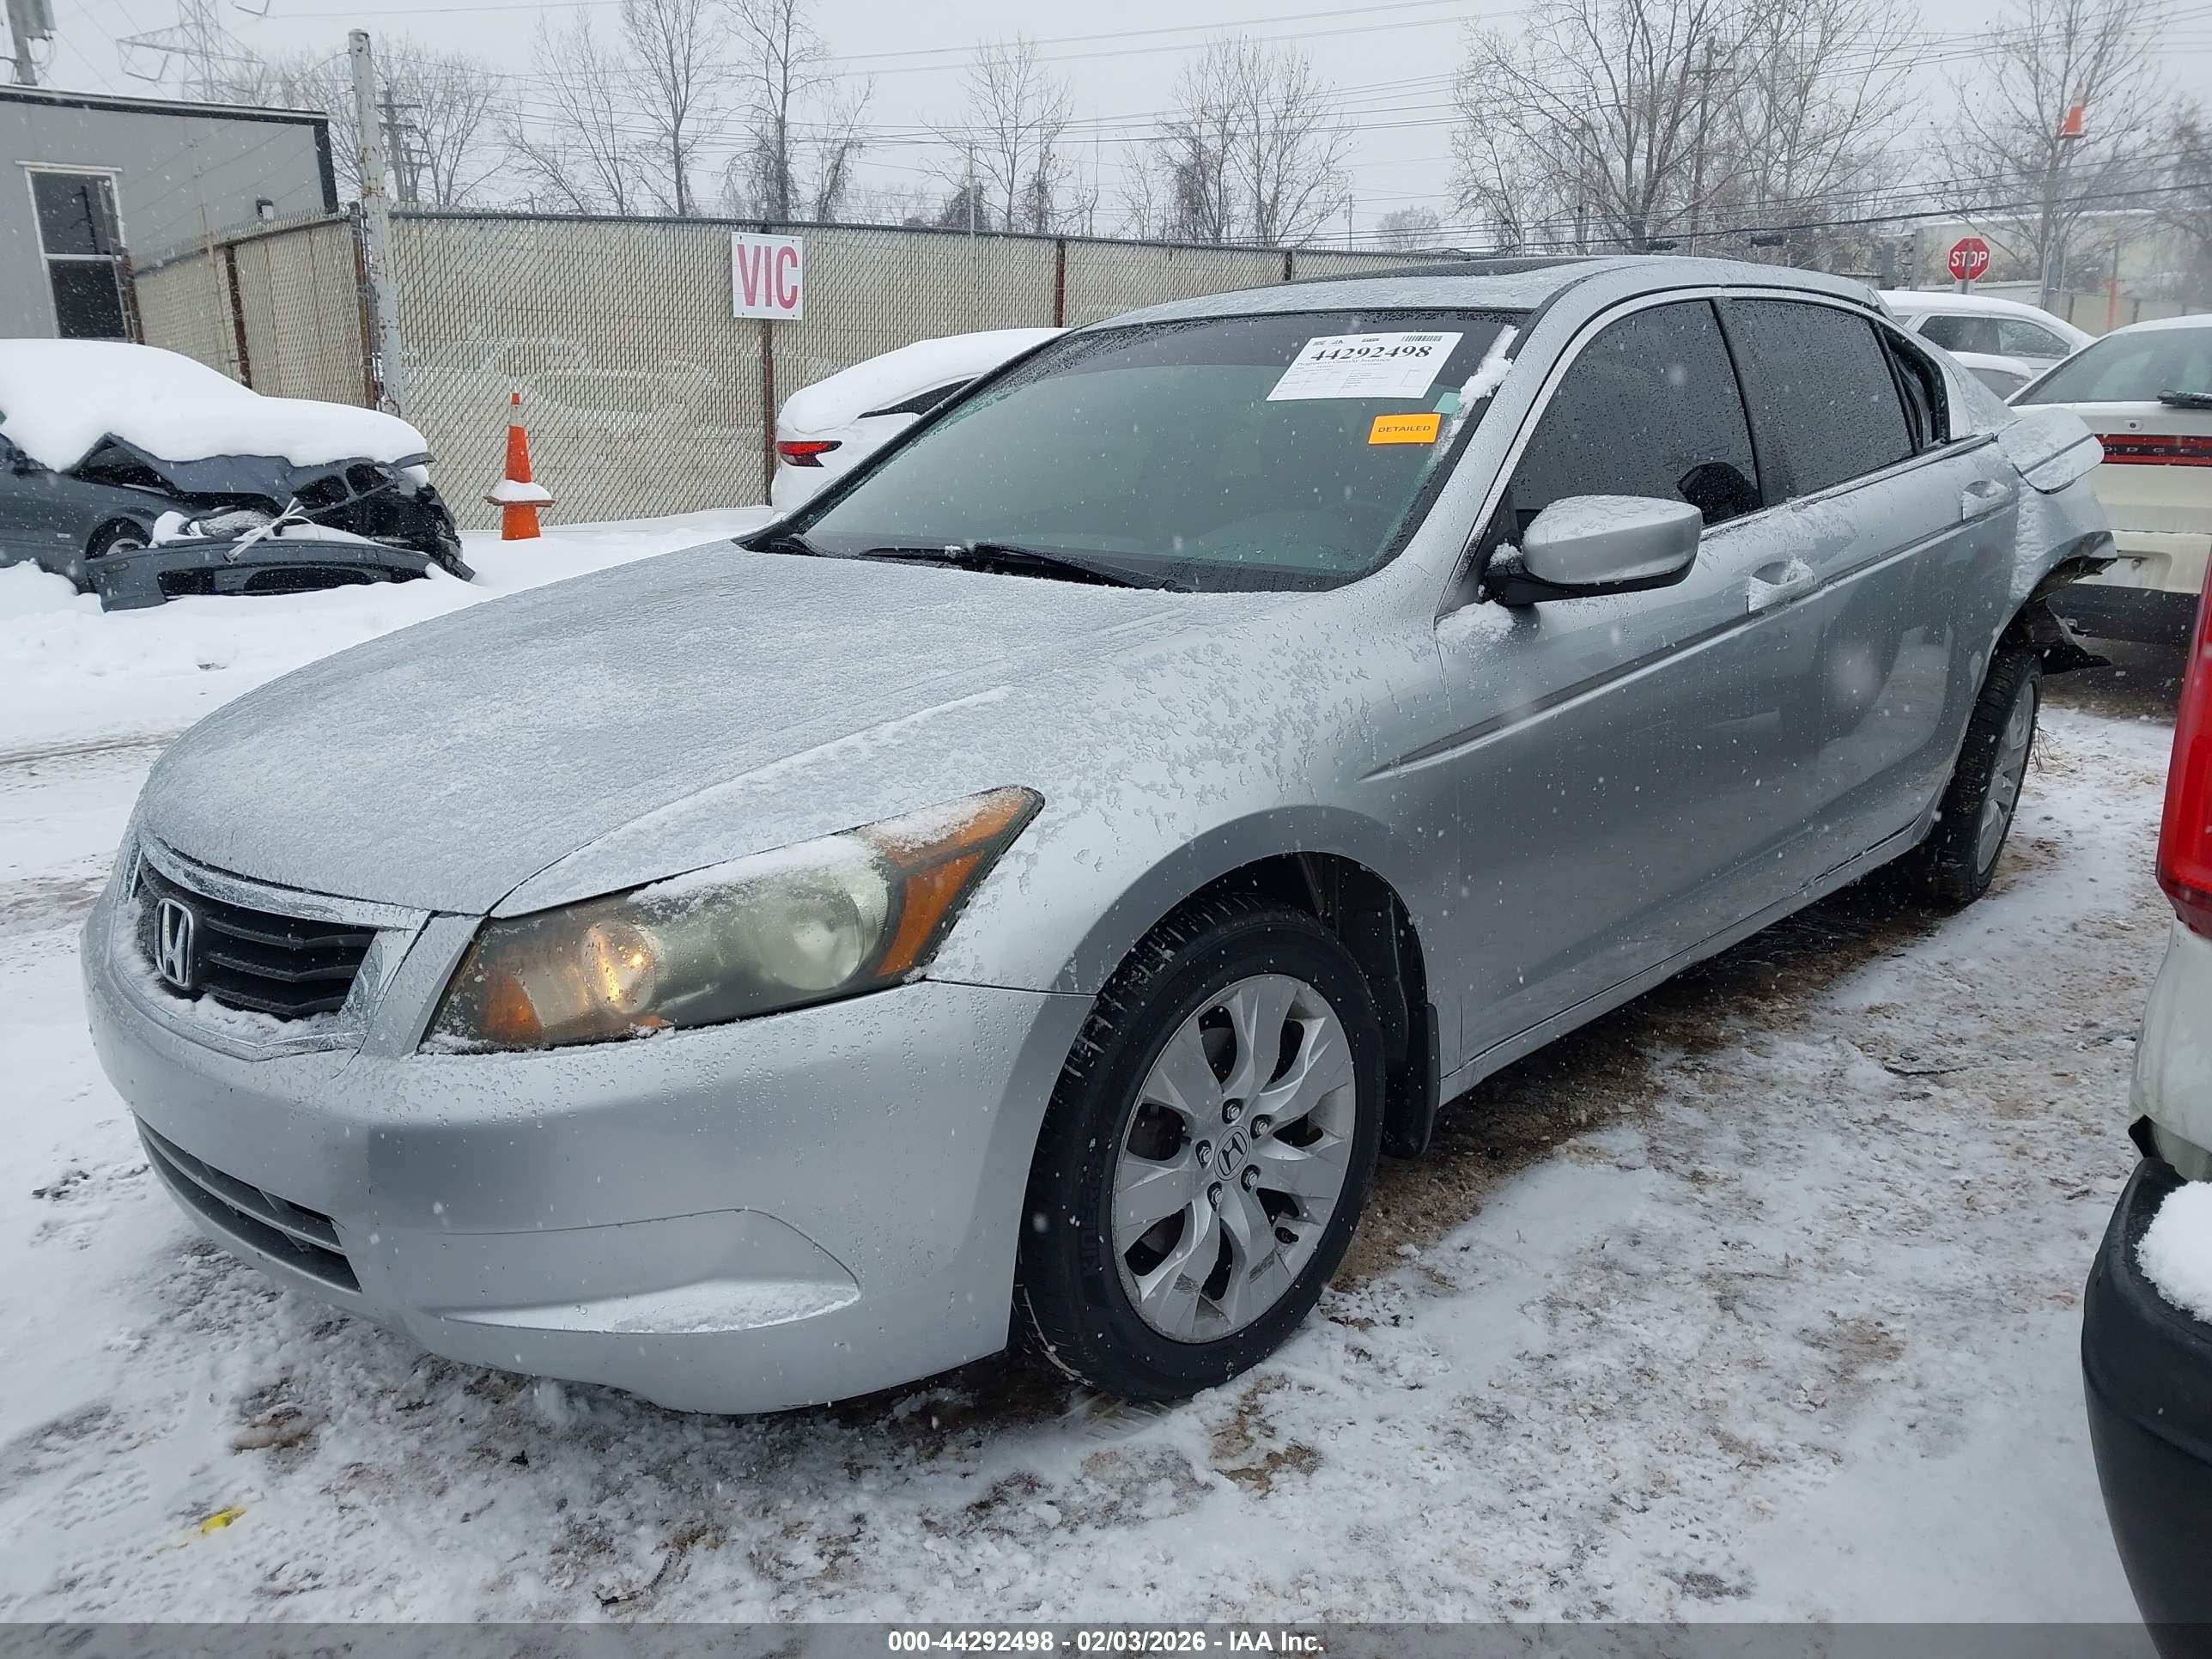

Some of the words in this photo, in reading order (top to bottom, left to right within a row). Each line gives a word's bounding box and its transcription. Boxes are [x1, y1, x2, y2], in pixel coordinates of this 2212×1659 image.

[1951, 251, 1988, 267] STOP
[737, 244, 798, 309] VIC
[1310, 345, 1433, 361] 44292498
